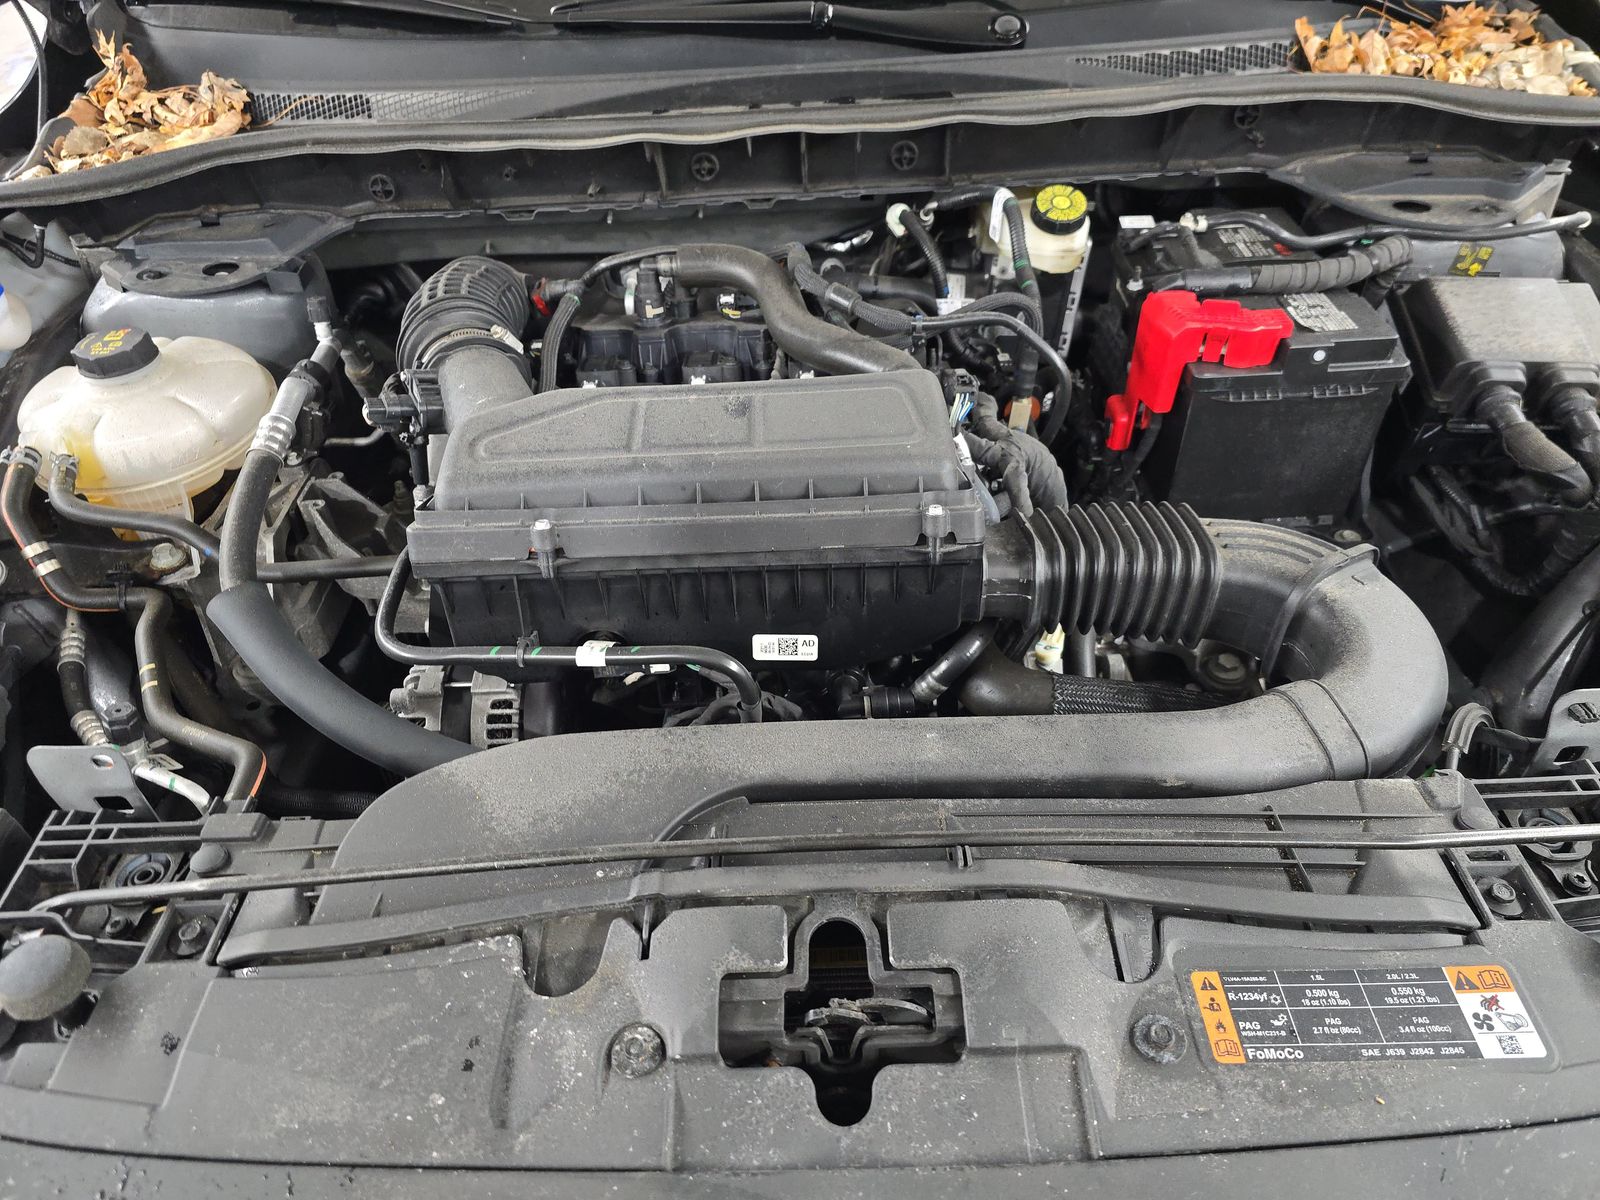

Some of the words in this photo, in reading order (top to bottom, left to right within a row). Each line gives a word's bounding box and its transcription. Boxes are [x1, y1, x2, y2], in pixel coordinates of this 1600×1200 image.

[802, 640, 815, 648] AD
[1306, 989, 1328, 998] 0.500
[1328, 989, 1340, 998] kg
[1390, 987, 1413, 996] 0.550
[1414, 987, 1426, 996] kg
[1227, 992, 1268, 1002] R-1234yf
[1408, 996, 1426, 1004] (1.21
[1426, 996, 1440, 1004] lbs)
[1320, 998, 1336, 1006] (1.10
[1338, 998, 1351, 1006] lbs)
[1238, 1022, 1261, 1030] PAG
[1312, 1026, 1323, 1034] 2.7
[1324, 1026, 1330, 1034] fl
[1339, 1026, 1362, 1035] (80cc)
[1425, 1025, 1452, 1034] (100cc)
[1246, 1048, 1304, 1060] FoMoCo
[1361, 1048, 1382, 1056] SAE
[1385, 1048, 1406, 1056] J639
[1409, 1047, 1435, 1056] J2842
[1440, 1046, 1466, 1054] J2845
